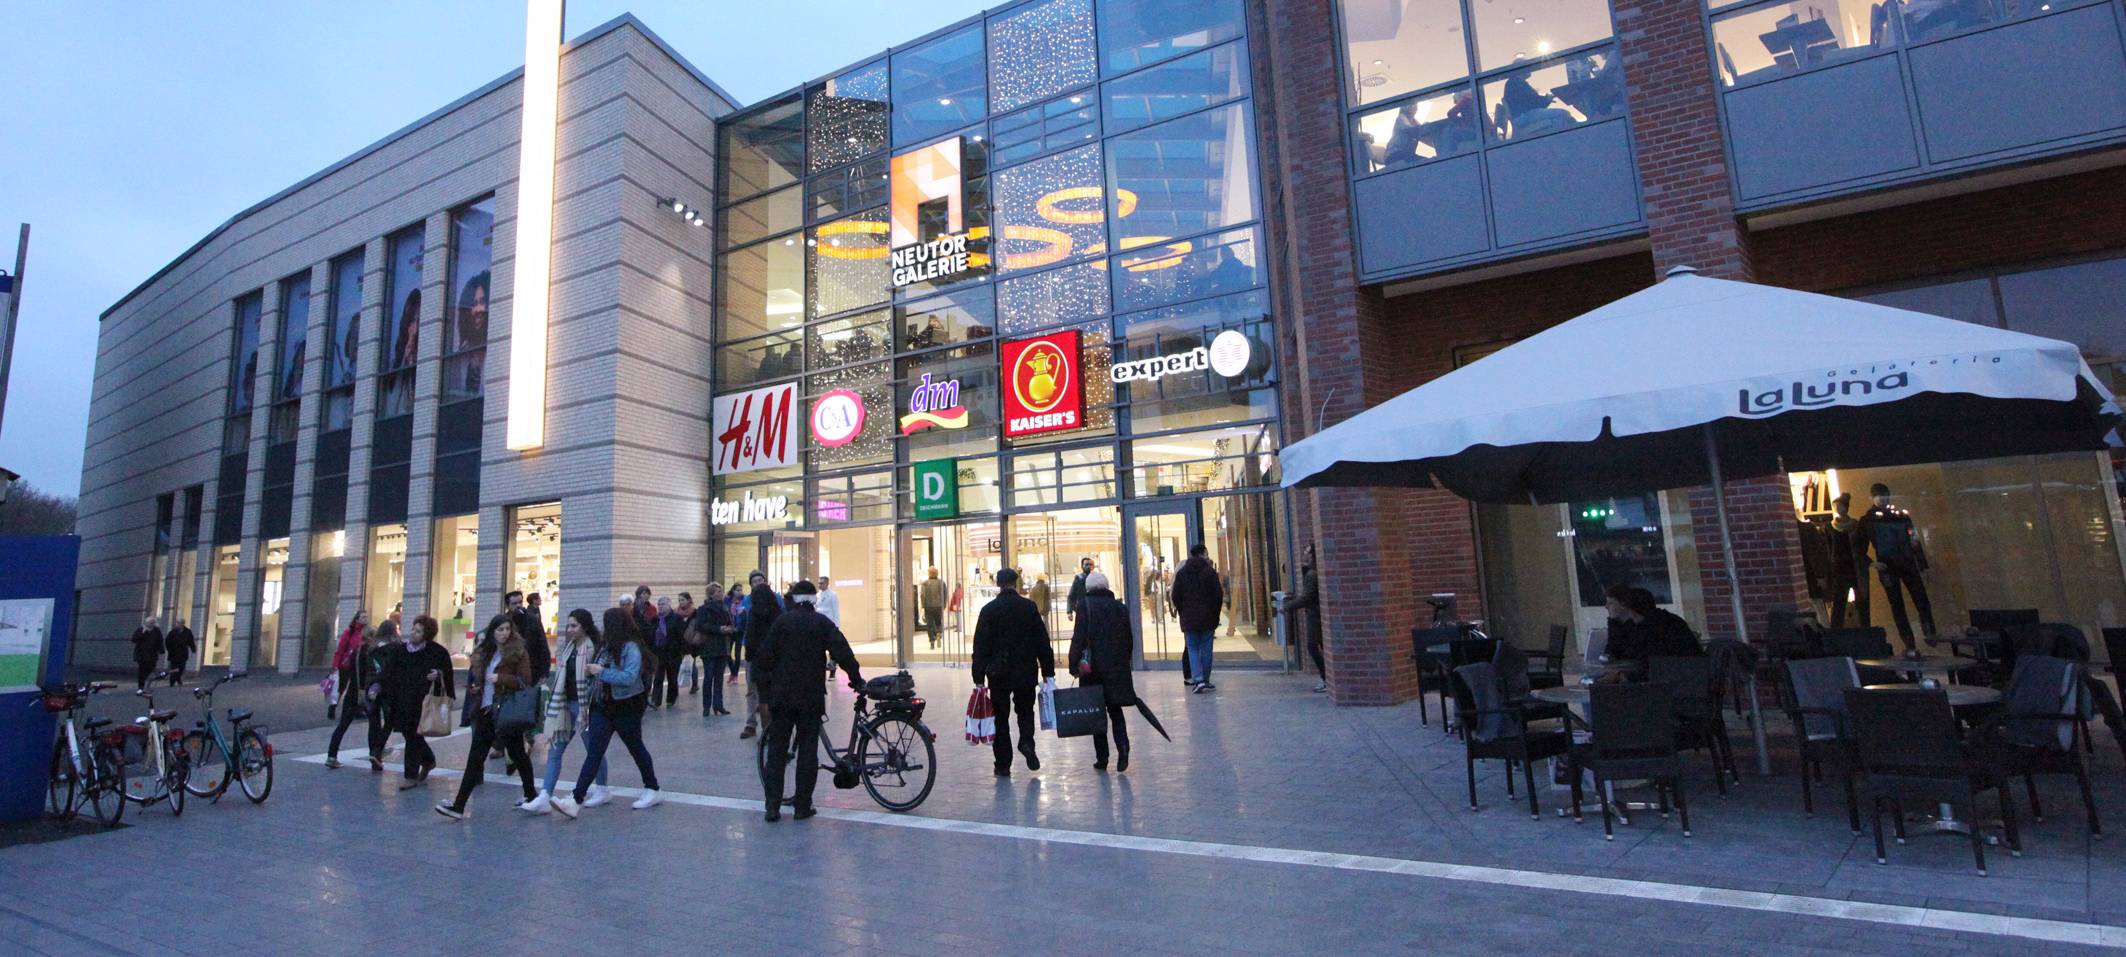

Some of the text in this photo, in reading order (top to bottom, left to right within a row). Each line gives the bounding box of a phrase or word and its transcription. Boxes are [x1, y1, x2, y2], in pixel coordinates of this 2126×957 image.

[892, 236, 966, 269] NEUTOR
[892, 253, 967, 287] GALERIE
[1112, 347, 1206, 381] expert
[910, 372, 960, 414] dm
[719, 386, 792, 471] H&M
[1010, 411, 1076, 432] KAISER'S
[922, 471, 945, 501] D
[711, 497, 740, 525] ten
[743, 491, 788, 522] have
